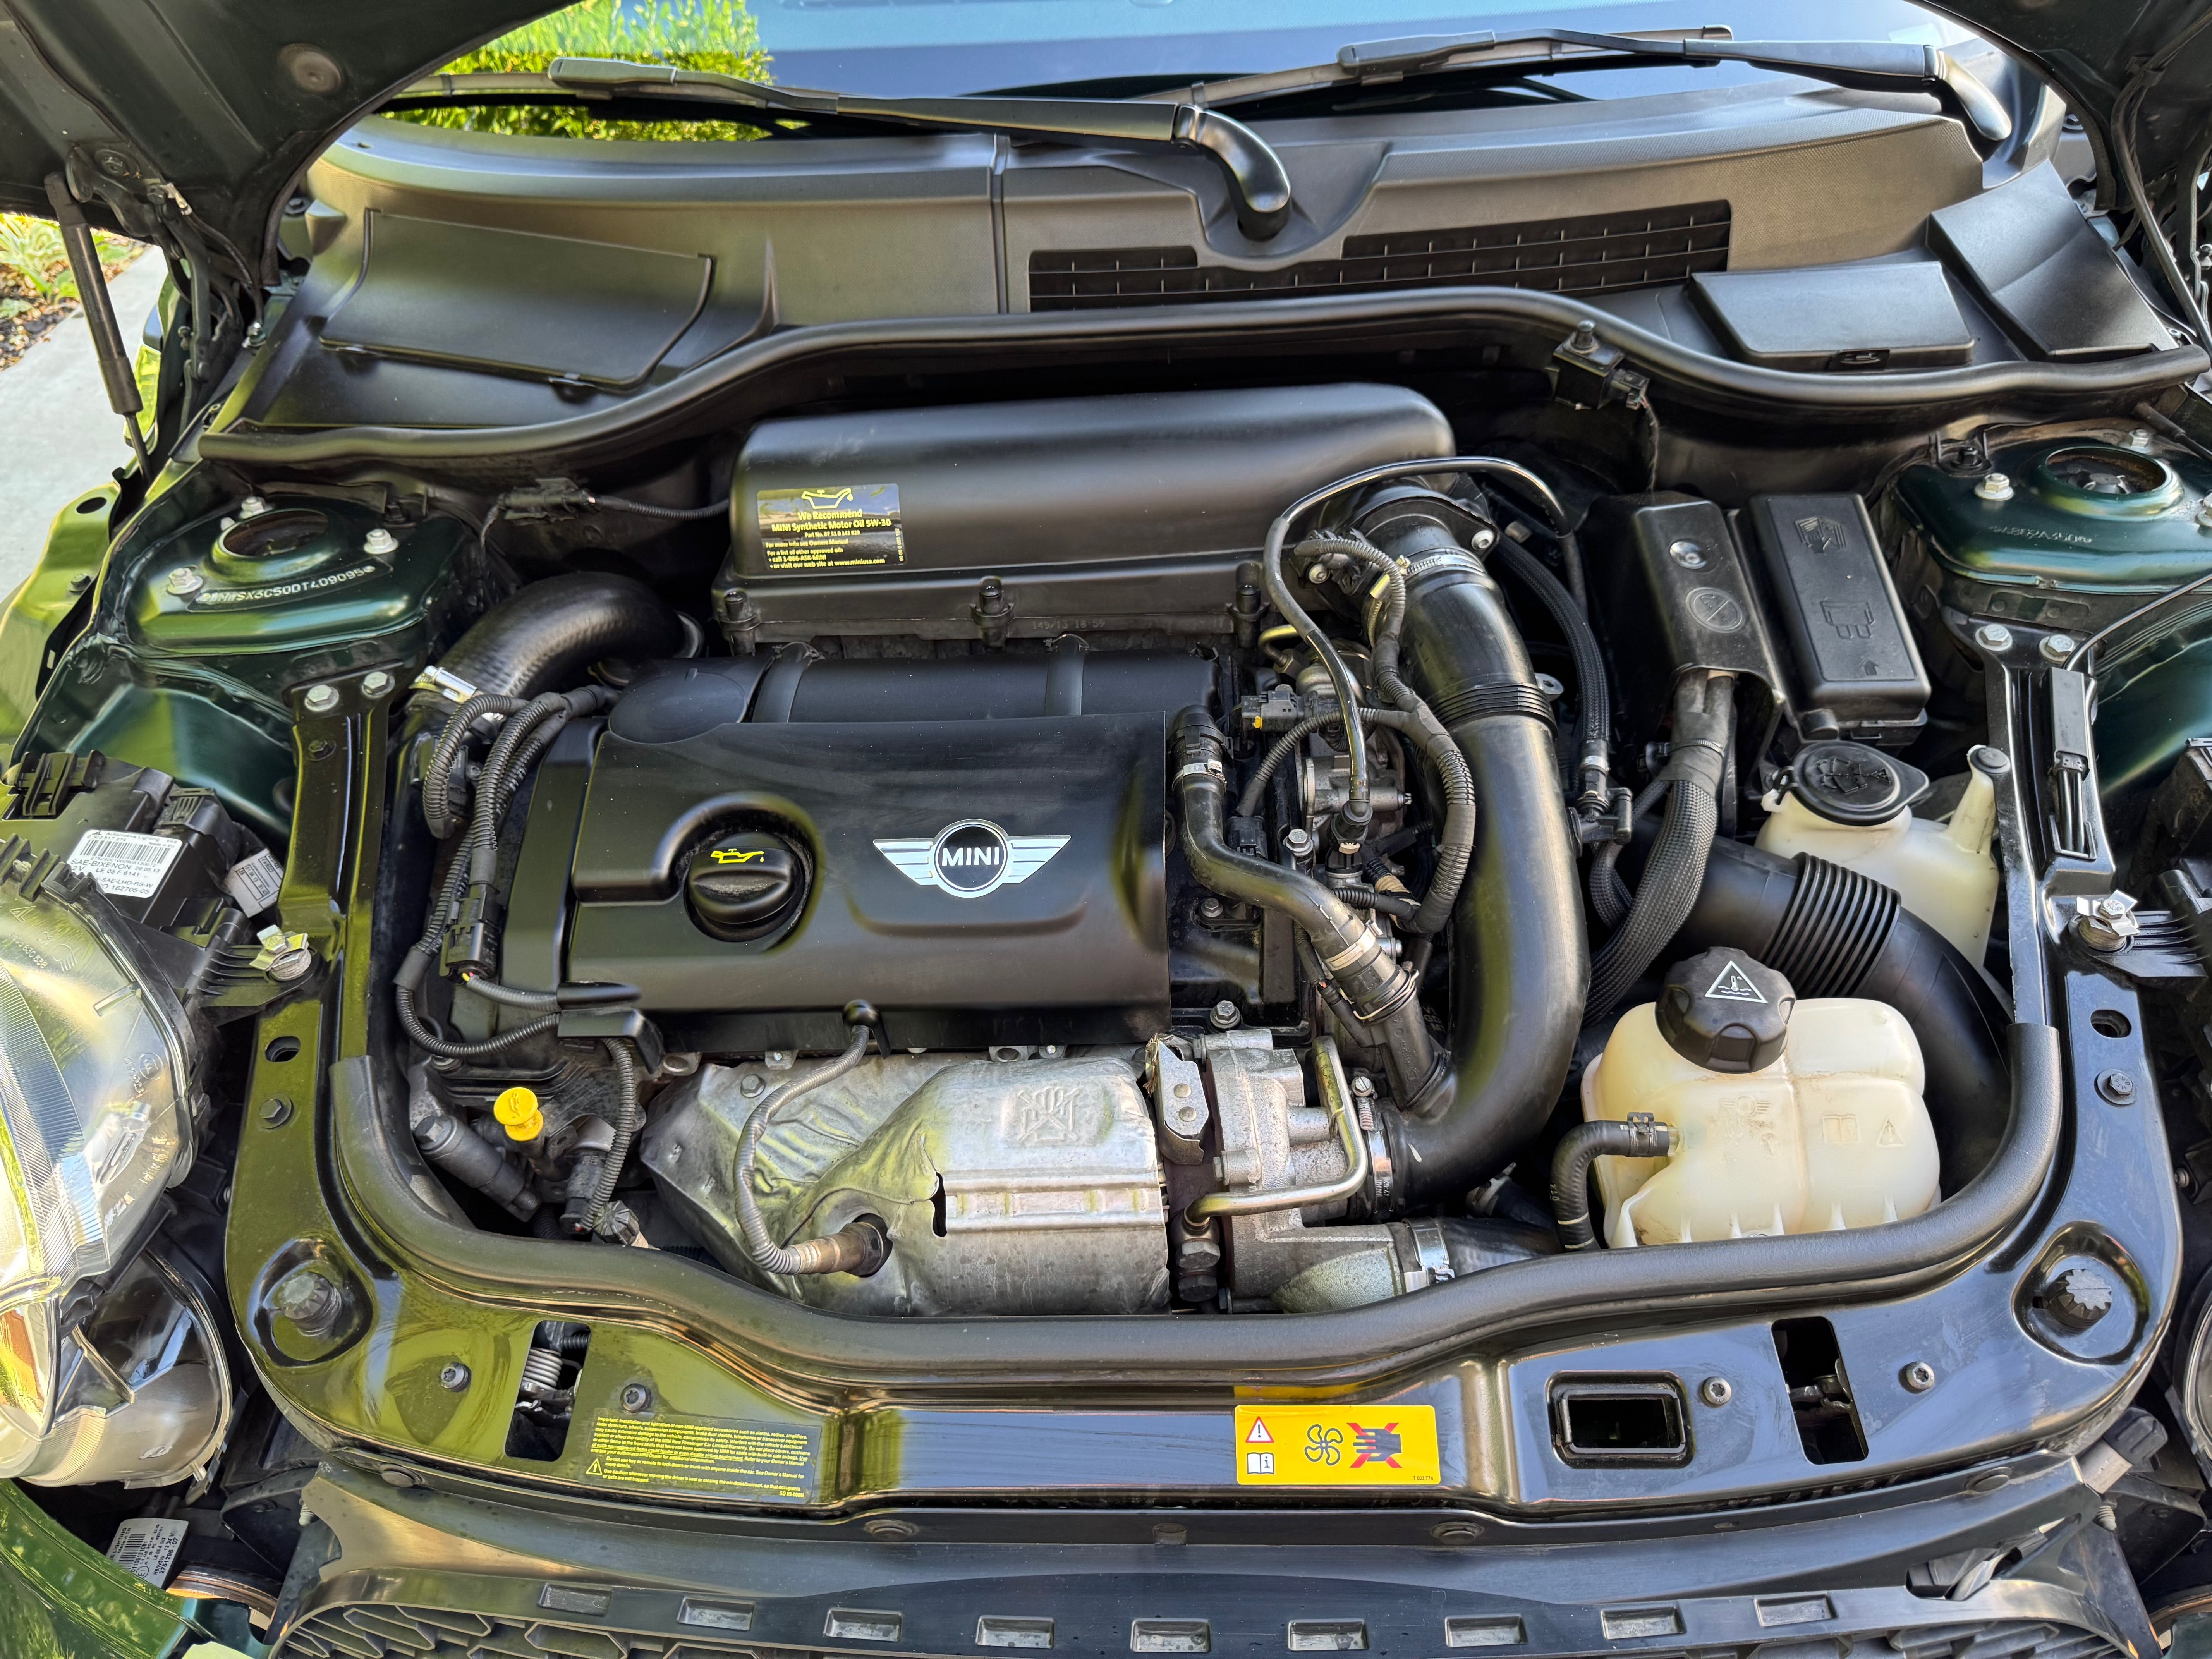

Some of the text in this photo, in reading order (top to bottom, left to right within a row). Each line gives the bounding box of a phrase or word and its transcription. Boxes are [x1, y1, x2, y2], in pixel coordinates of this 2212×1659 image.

[798, 509, 862, 520] We Recommend
[771, 519, 891, 533] MINI Synthetic Motor Oil 5W-30
[942, 847, 999, 866] MINI
[71, 859, 131, 870] SAE-BIXENON
[112, 885, 150, 895] 162705-05
